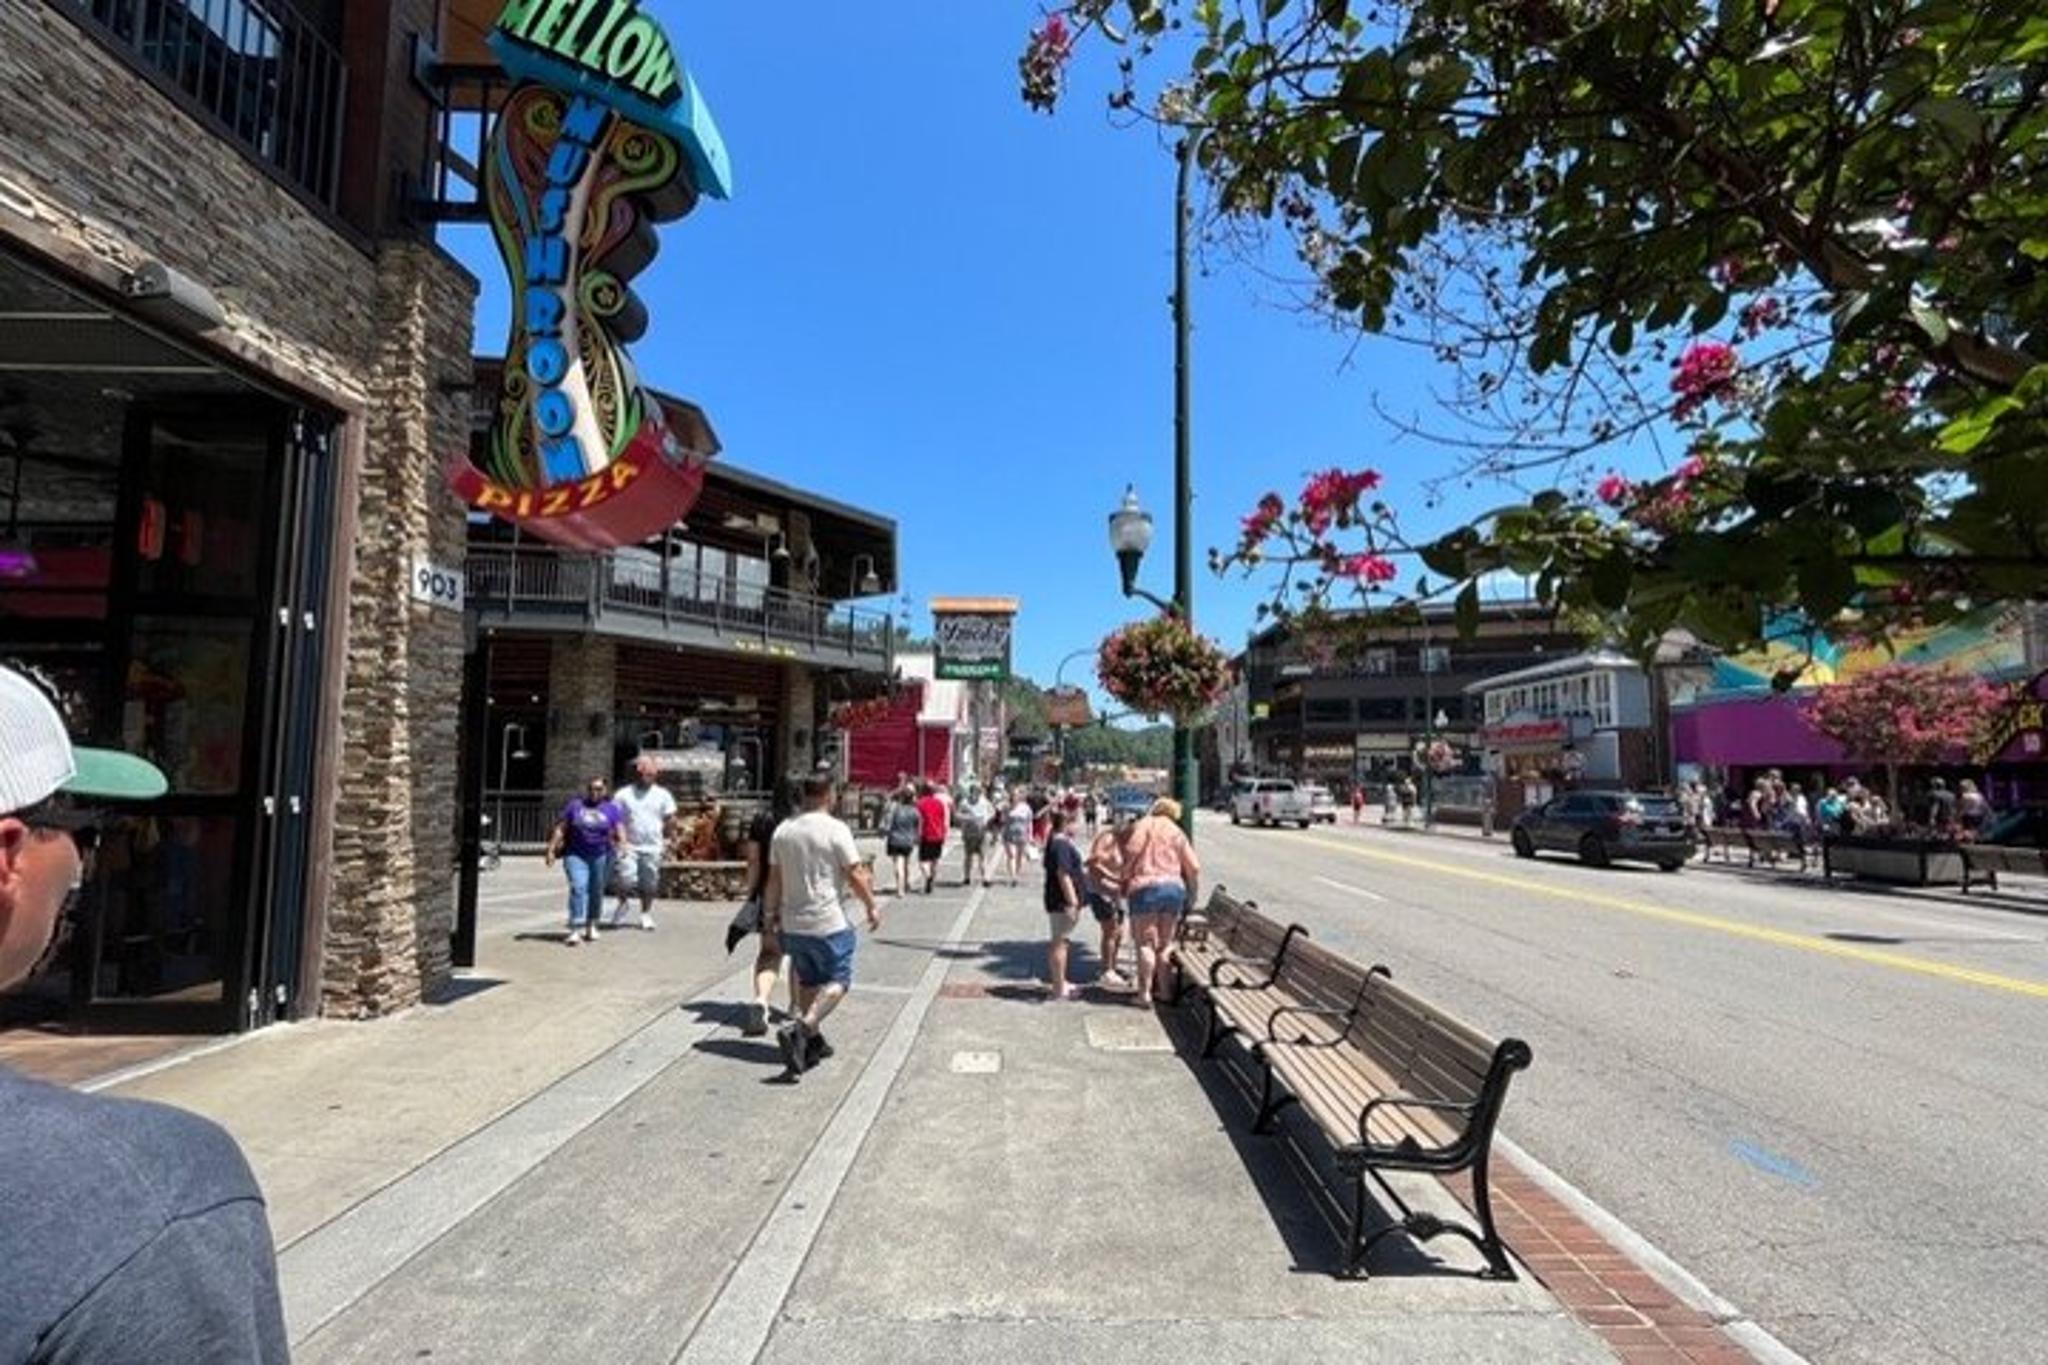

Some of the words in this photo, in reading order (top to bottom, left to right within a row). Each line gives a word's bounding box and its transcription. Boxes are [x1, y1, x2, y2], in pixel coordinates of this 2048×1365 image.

[524, 95, 609, 486] MUSHROOM
[475, 461, 638, 516] PIZZA
[416, 568, 457, 600] 903
